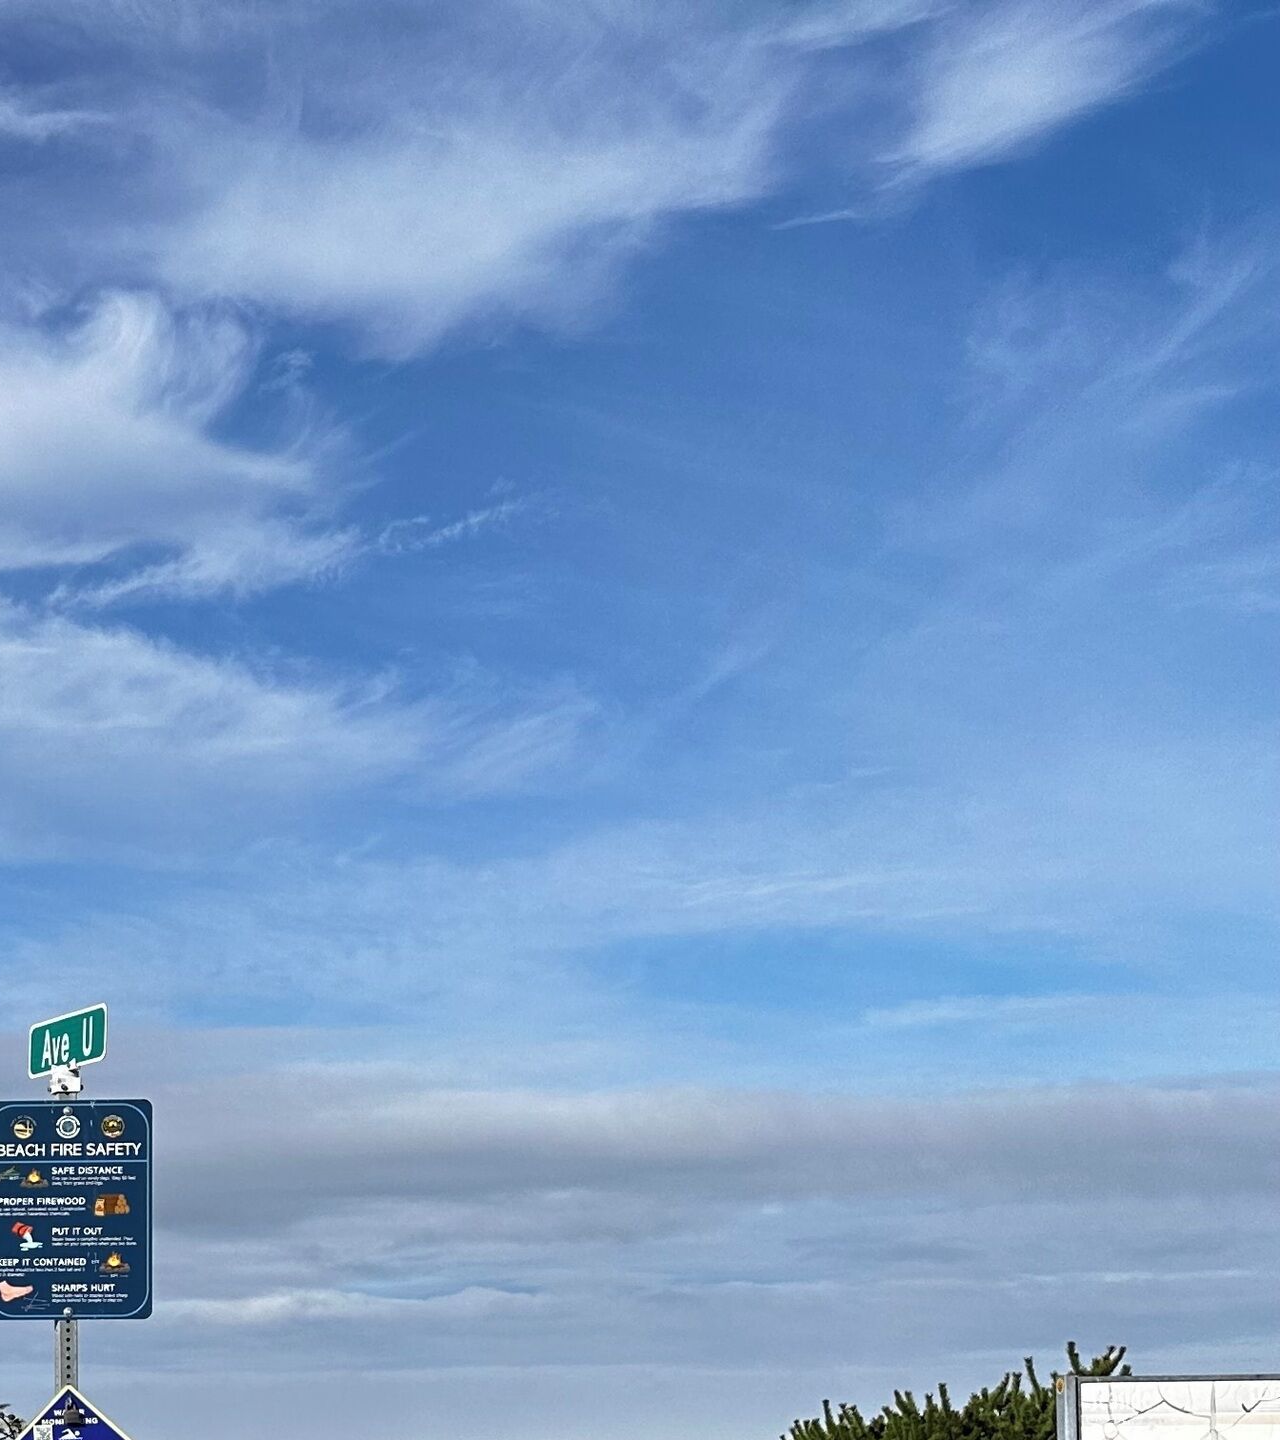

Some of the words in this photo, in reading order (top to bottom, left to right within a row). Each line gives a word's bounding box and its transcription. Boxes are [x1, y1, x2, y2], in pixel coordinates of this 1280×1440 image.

[41, 1029, 70, 1069] Ave
[83, 1015, 93, 1057] U
[51, 1143, 82, 1157] FIRE
[86, 1142, 142, 1157] SAFETY
[51, 1166, 75, 1175] SAFE
[78, 1166, 124, 1175] DISTANCE
[36, 1196, 86, 1206] FIREWOOD
[51, 1227, 70, 1236] PUT
[72, 1227, 81, 1236] IT
[83, 1226, 103, 1236] OUT
[22, 1258, 31, 1267] IT
[33, 1257, 87, 1267] CONTAINED
[51, 1283, 89, 1293] SHARPS
[91, 1283, 116, 1292] HURT
